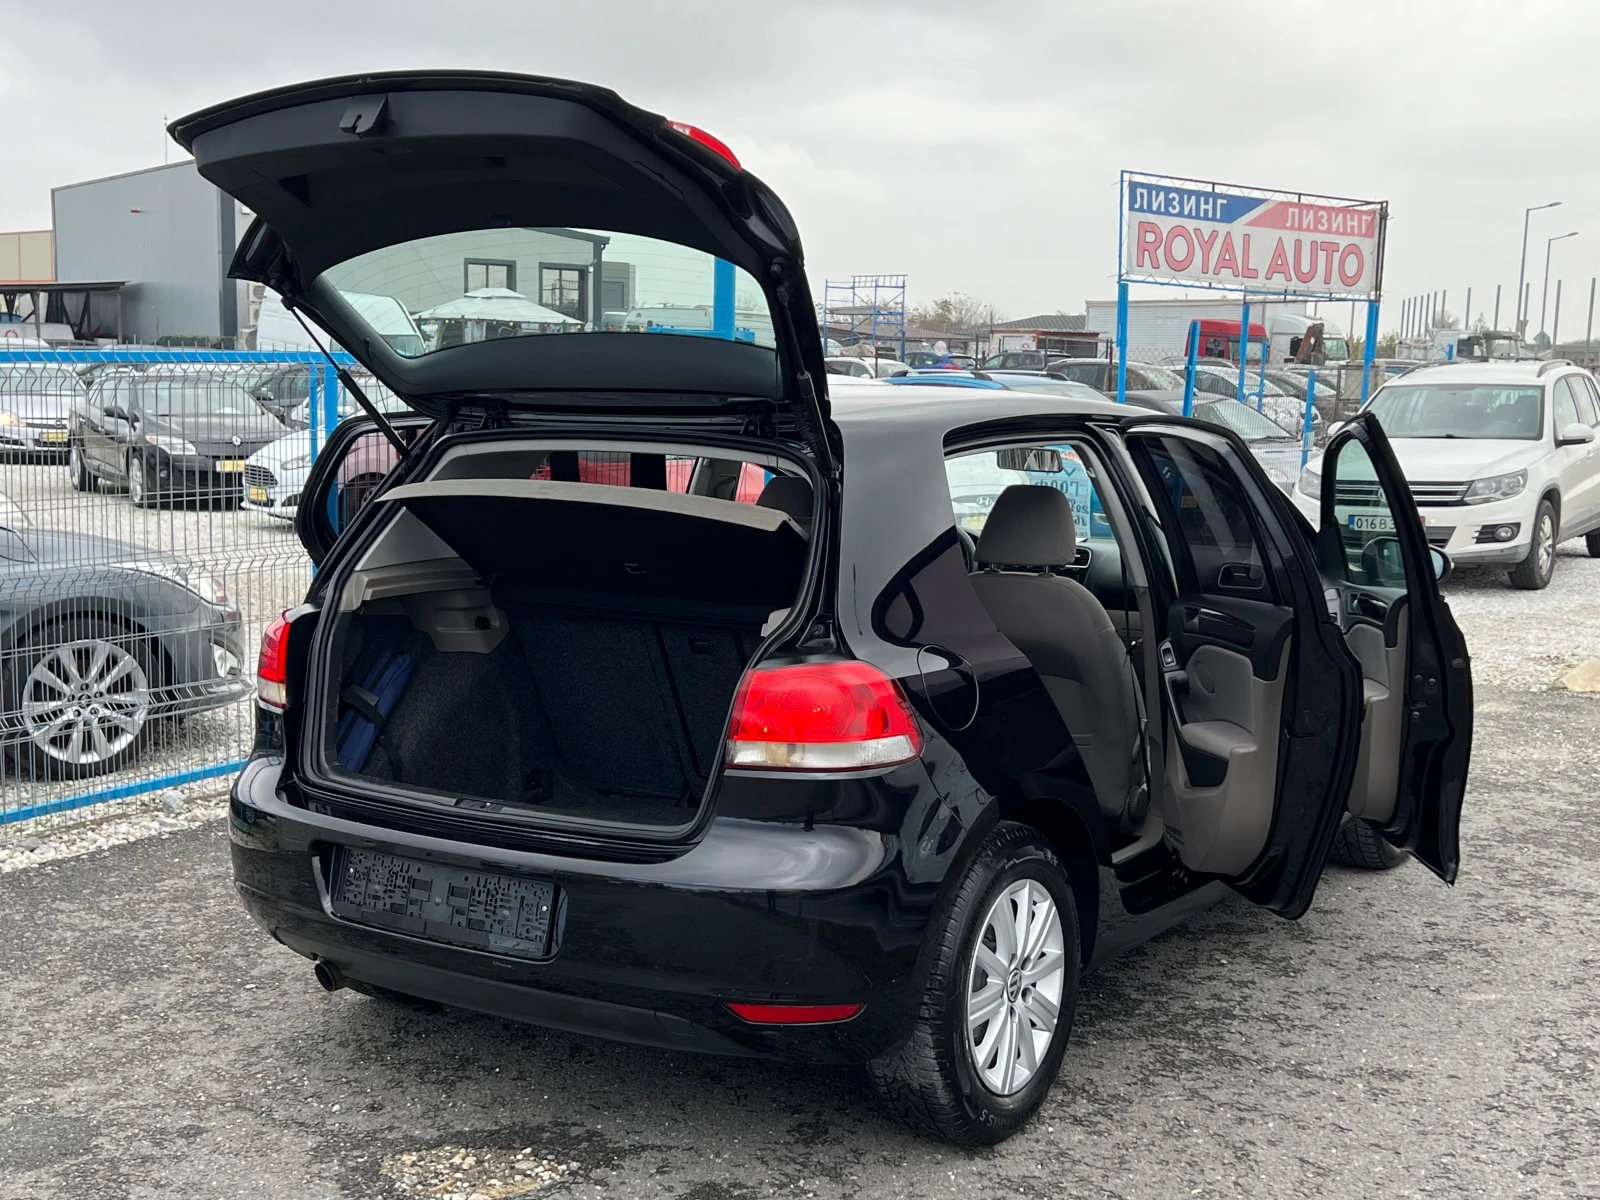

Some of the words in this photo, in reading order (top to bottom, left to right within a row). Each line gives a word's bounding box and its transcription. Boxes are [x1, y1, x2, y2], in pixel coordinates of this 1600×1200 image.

[1134, 187, 1228, 220] ЛИЗИНГ
[1286, 207, 1373, 235] ЛИЗИНГ
[1136, 220, 1259, 280] ROYAL
[1265, 236, 1364, 287] AUTO
